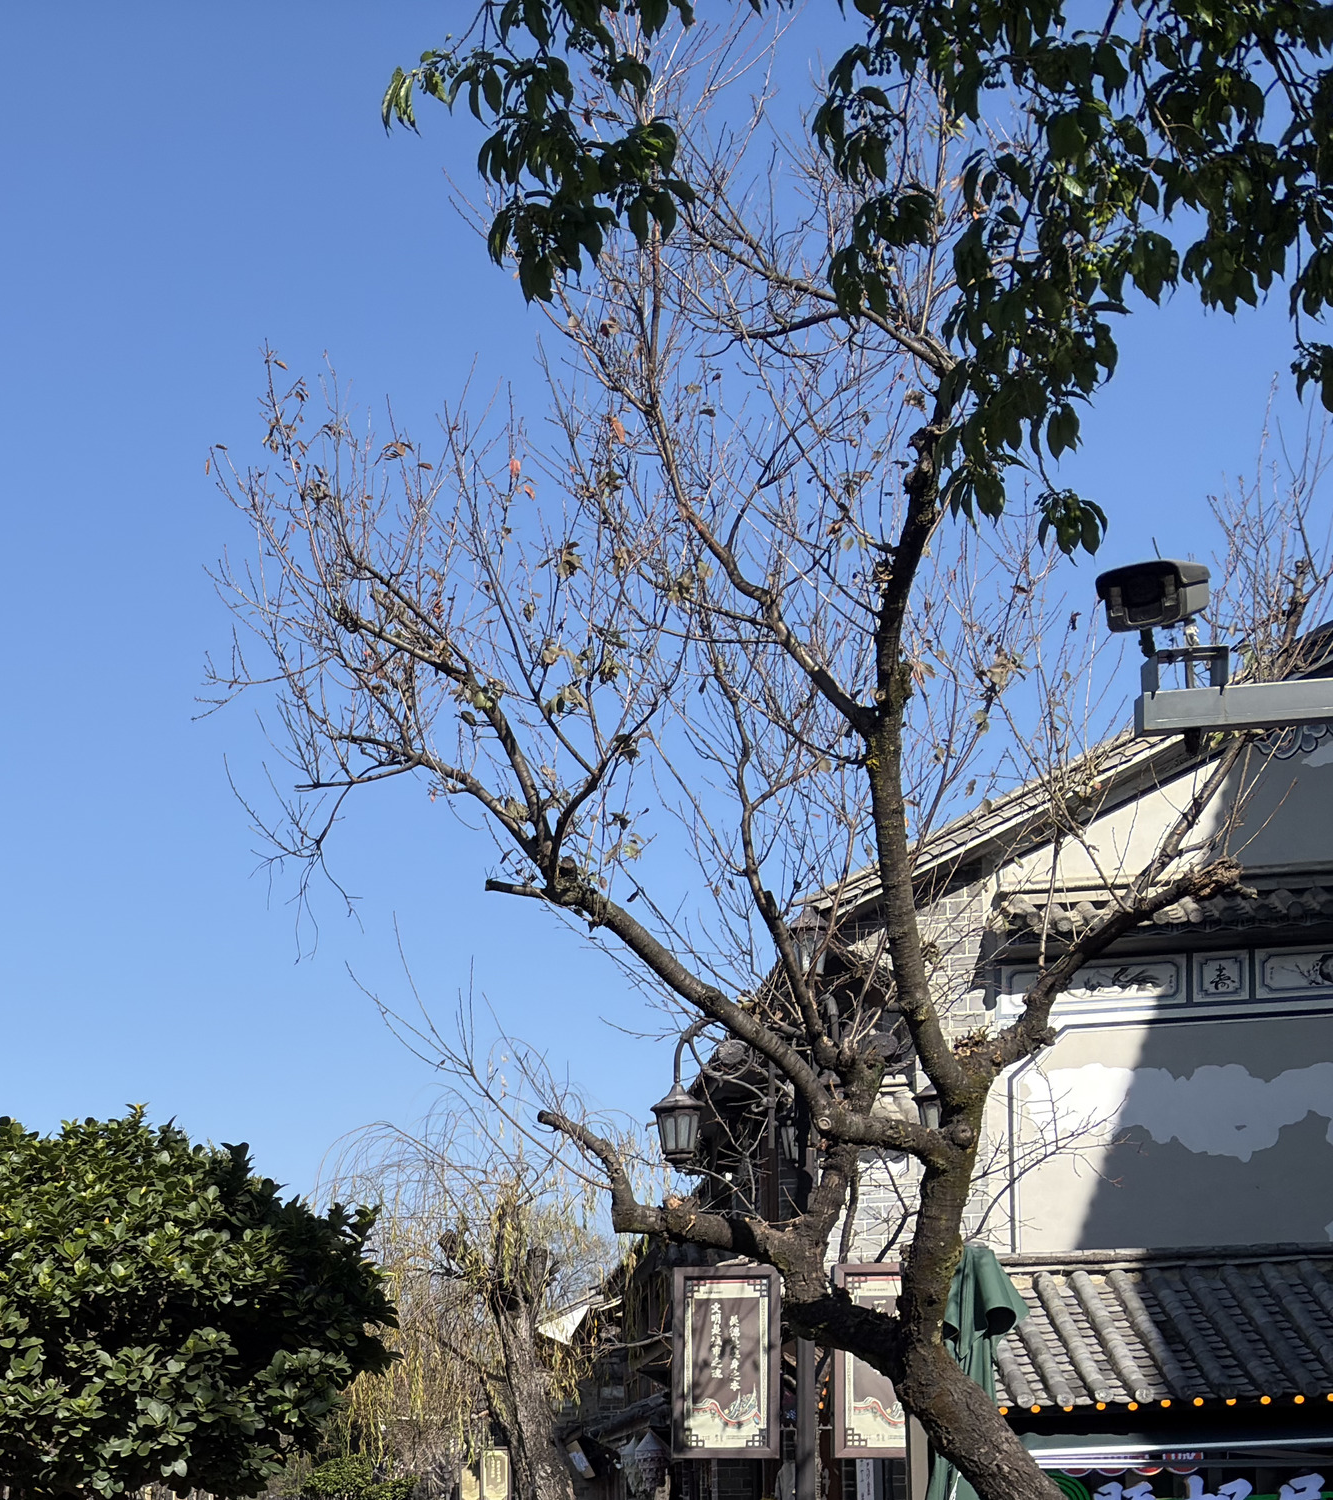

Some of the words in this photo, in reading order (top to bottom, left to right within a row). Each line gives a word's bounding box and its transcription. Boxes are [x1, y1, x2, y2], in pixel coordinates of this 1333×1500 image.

[710, 1302, 723, 1379] 文明是城市之魂
